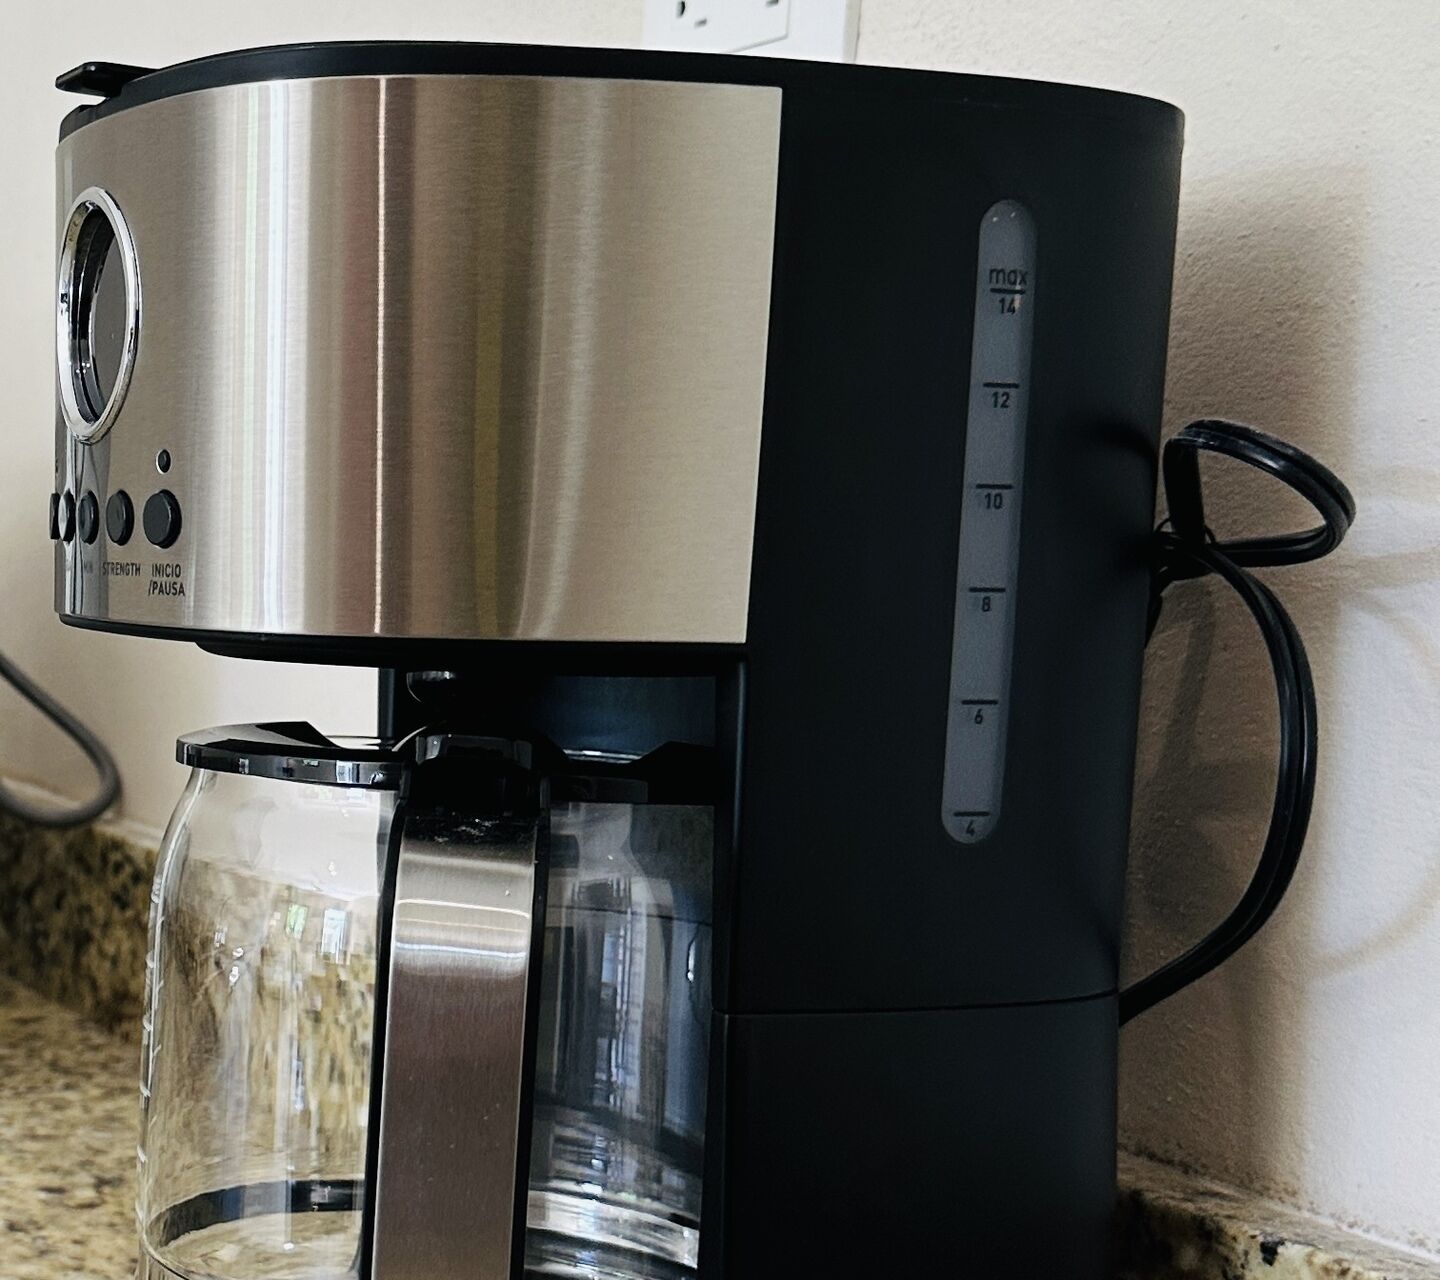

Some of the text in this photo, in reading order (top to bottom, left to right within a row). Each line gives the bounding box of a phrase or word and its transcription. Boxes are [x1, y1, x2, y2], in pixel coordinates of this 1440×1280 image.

[988, 268, 1028, 286] max
[998, 297, 1017, 315] 14
[991, 391, 1011, 409] 12
[984, 492, 1003, 510] 10
[102, 561, 141, 577] STRENGTH
[151, 563, 181, 578] INICIO
[148, 579, 186, 597] /PAUSA
[981, 596, 991, 613] 8
[974, 708, 984, 725] 6
[966, 821, 976, 836] 4
